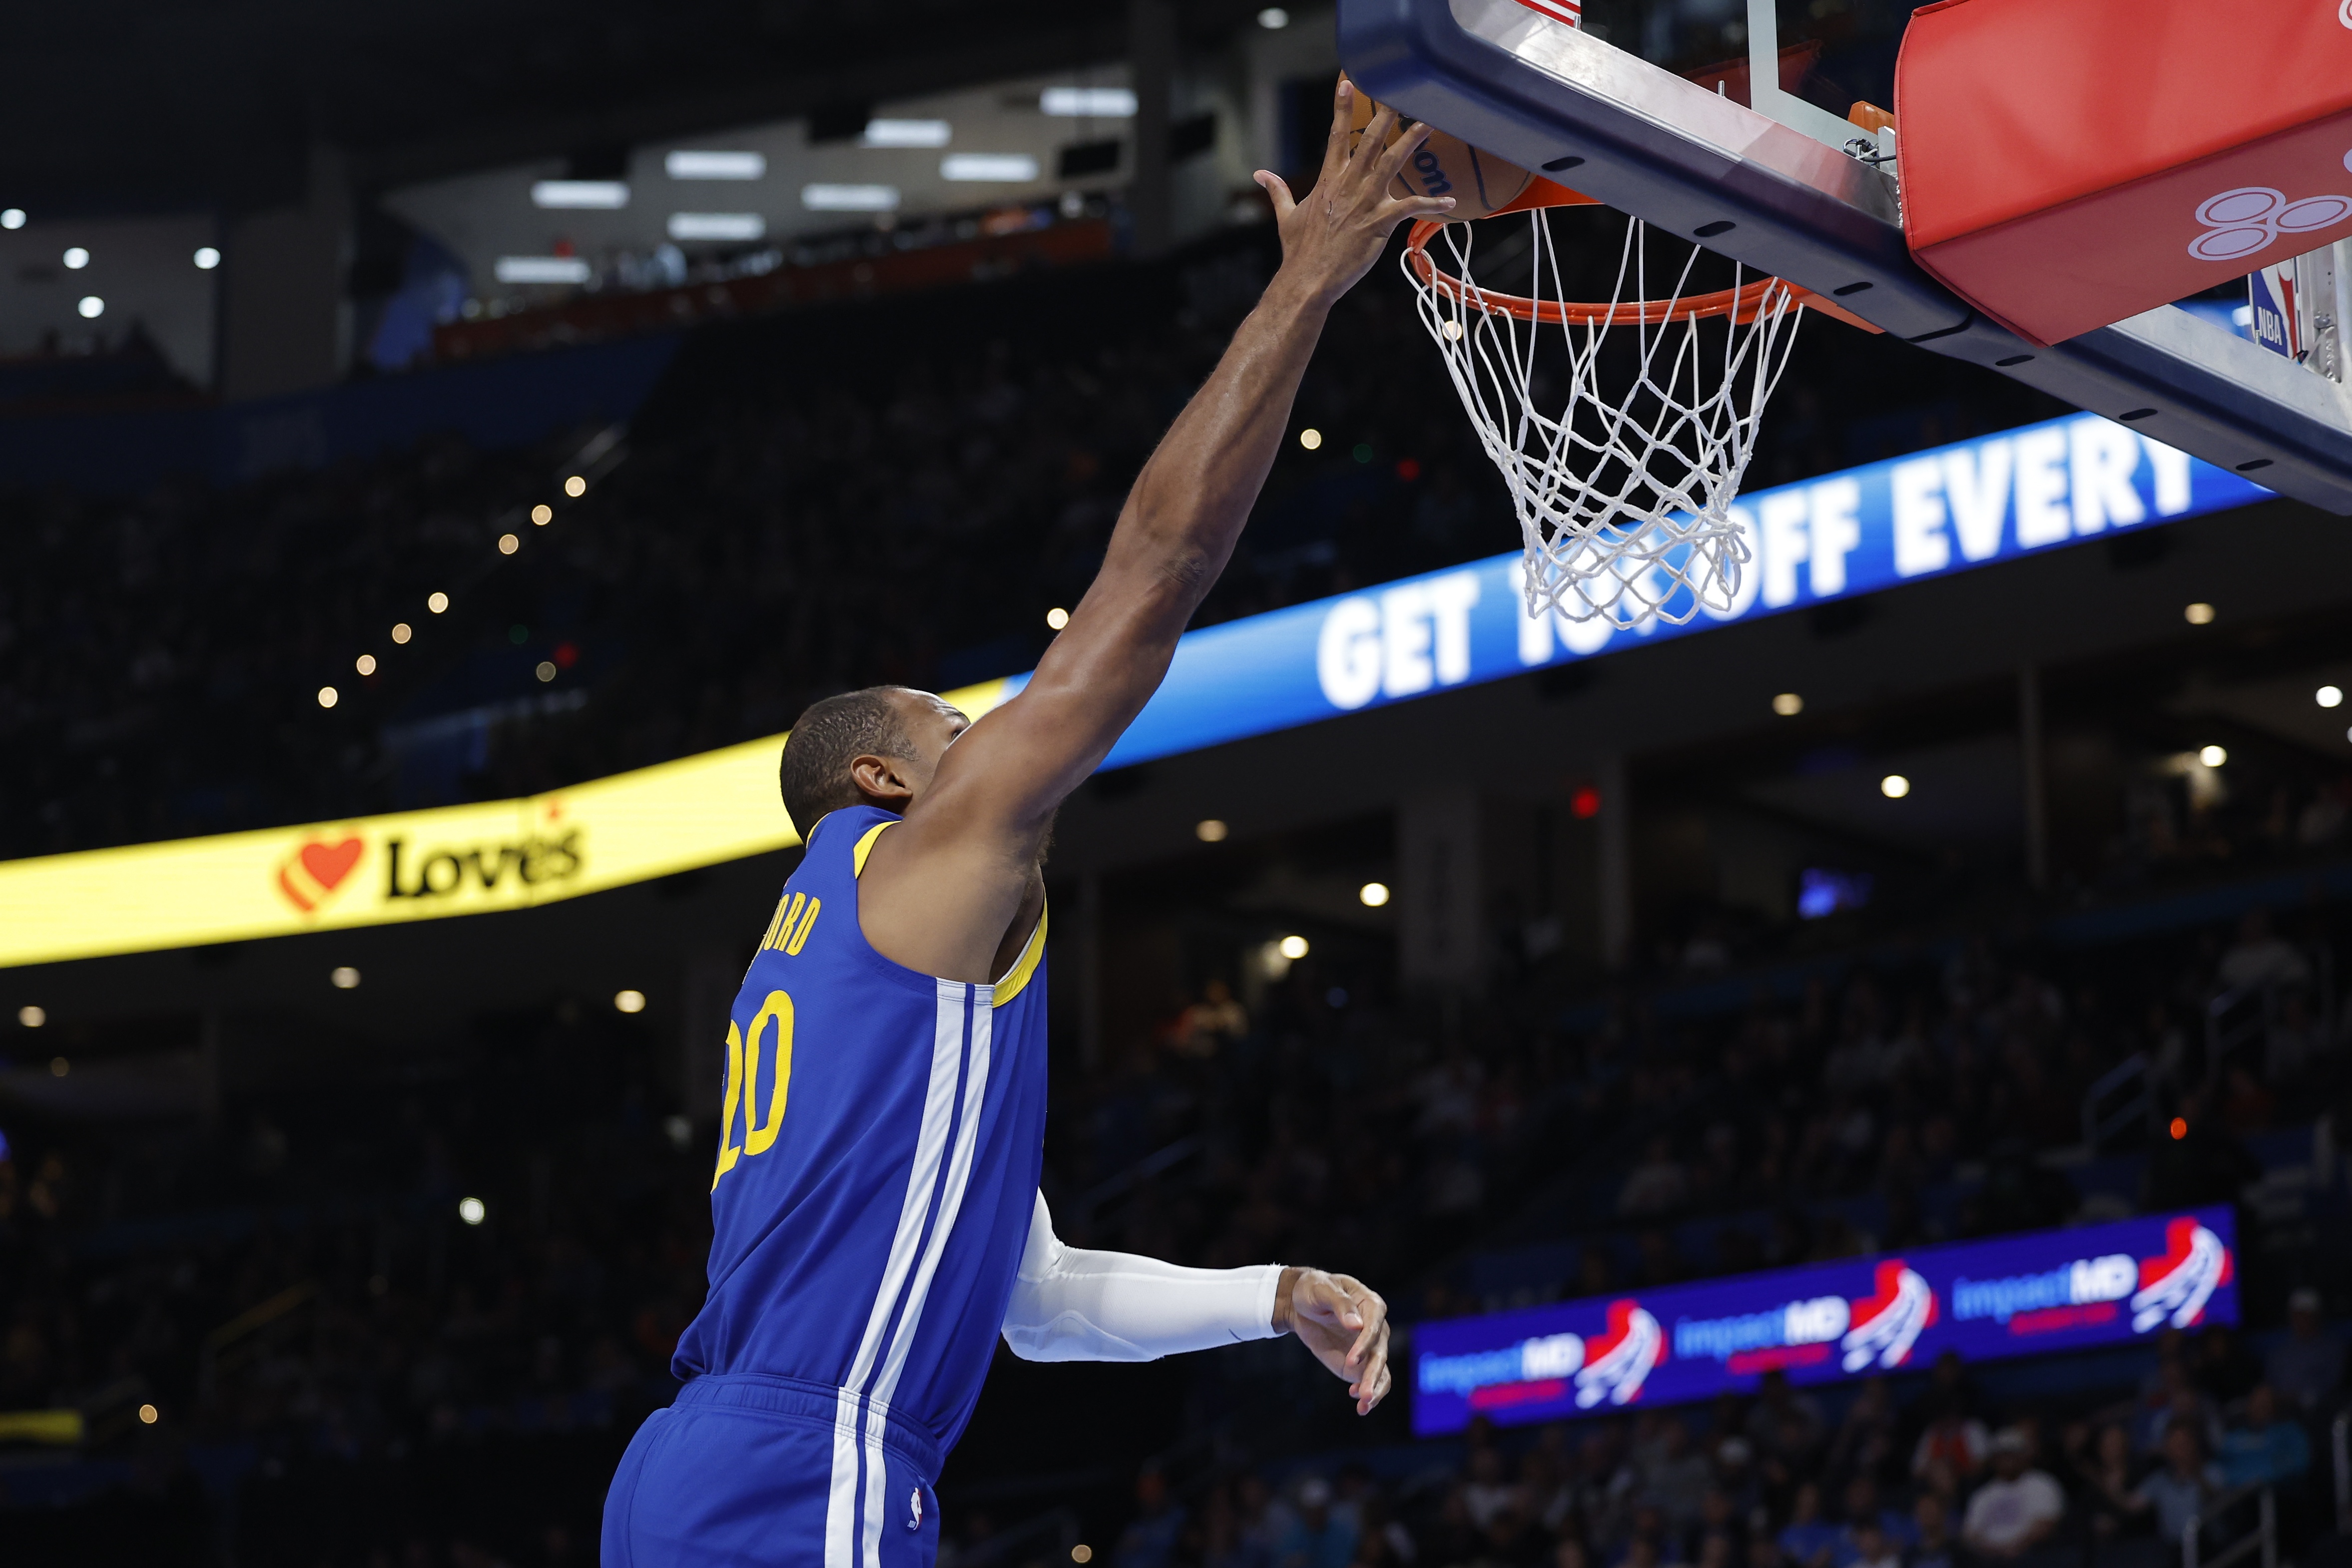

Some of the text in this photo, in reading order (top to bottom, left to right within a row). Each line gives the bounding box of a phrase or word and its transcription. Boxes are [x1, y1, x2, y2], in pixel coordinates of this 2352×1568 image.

[2258, 306, 2283, 346] NBA
[1316, 570, 1480, 710] GET
[1690, 475, 1860, 621] OFF
[1890, 415, 2192, 578] EVERY
[710, 990, 794, 1194] 20
[1952, 1253, 2139, 1325] impactMD
[1675, 1295, 1850, 1363] impactMD
